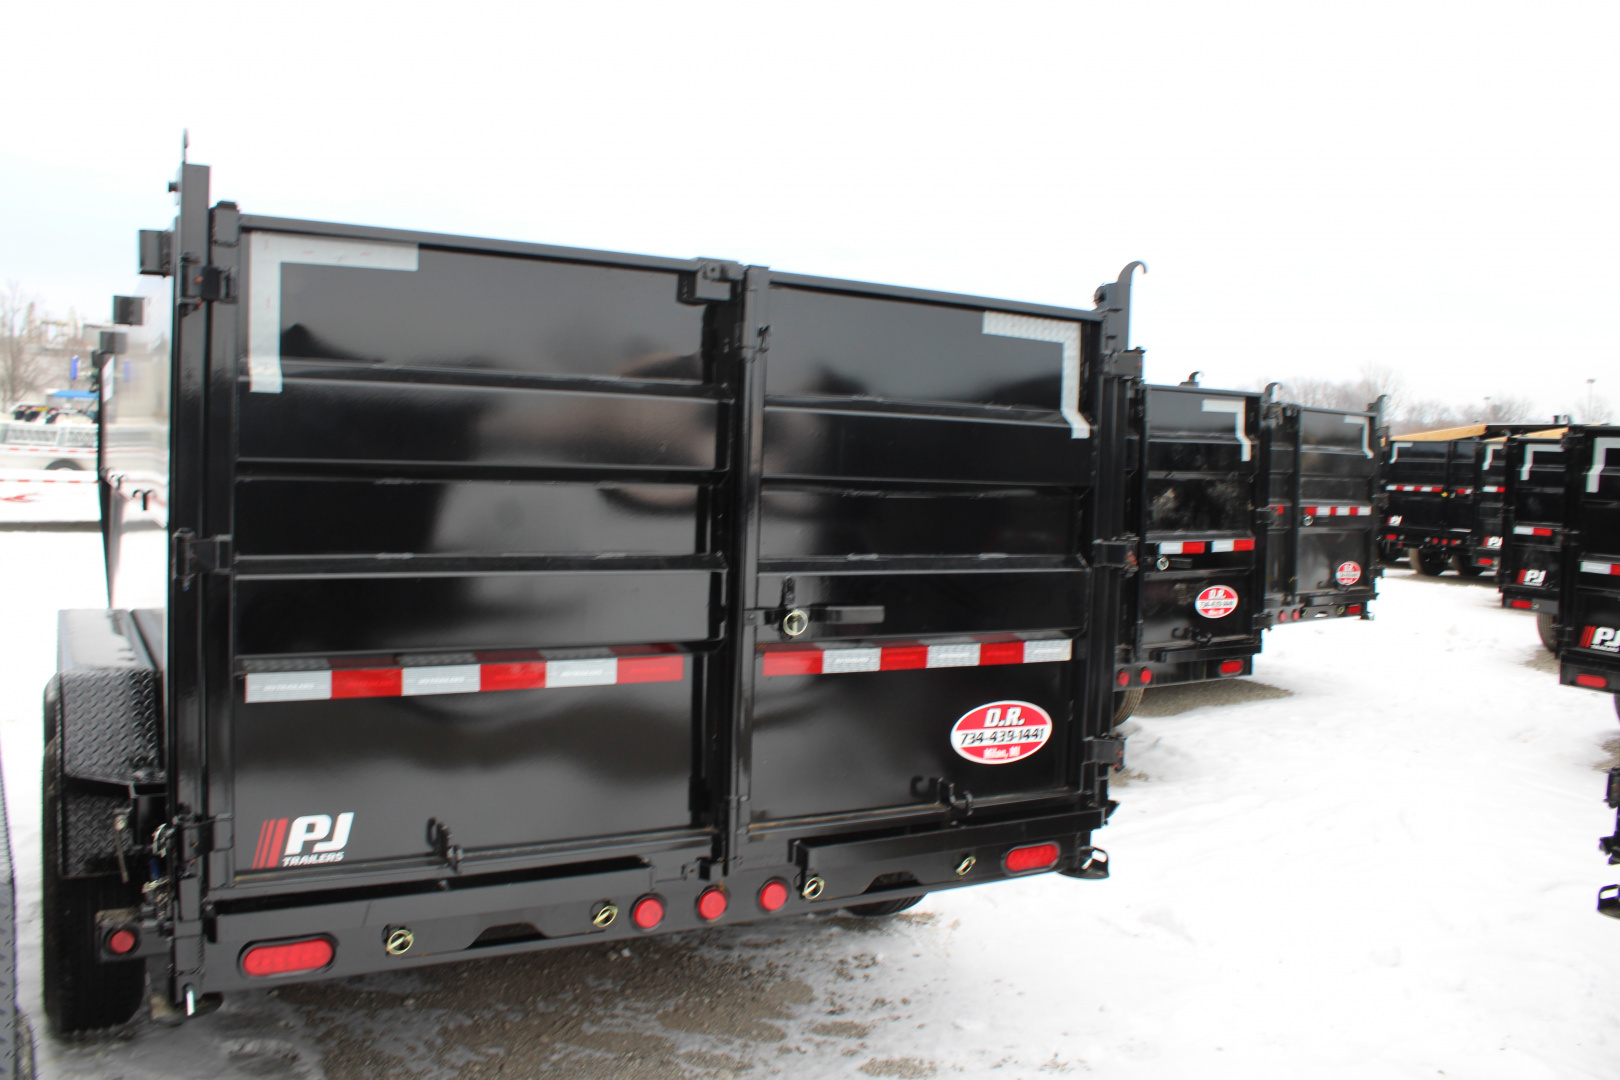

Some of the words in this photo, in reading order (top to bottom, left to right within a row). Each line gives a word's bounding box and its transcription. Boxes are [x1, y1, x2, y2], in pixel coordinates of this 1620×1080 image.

[1524, 569, 1547, 582] PJ
[1591, 626, 1620, 647] PJ
[983, 707, 1026, 728] D.R.
[960, 727, 1046, 746] 734-439-1441
[284, 811, 355, 856] PJ
[282, 851, 345, 868] TRAILERS
